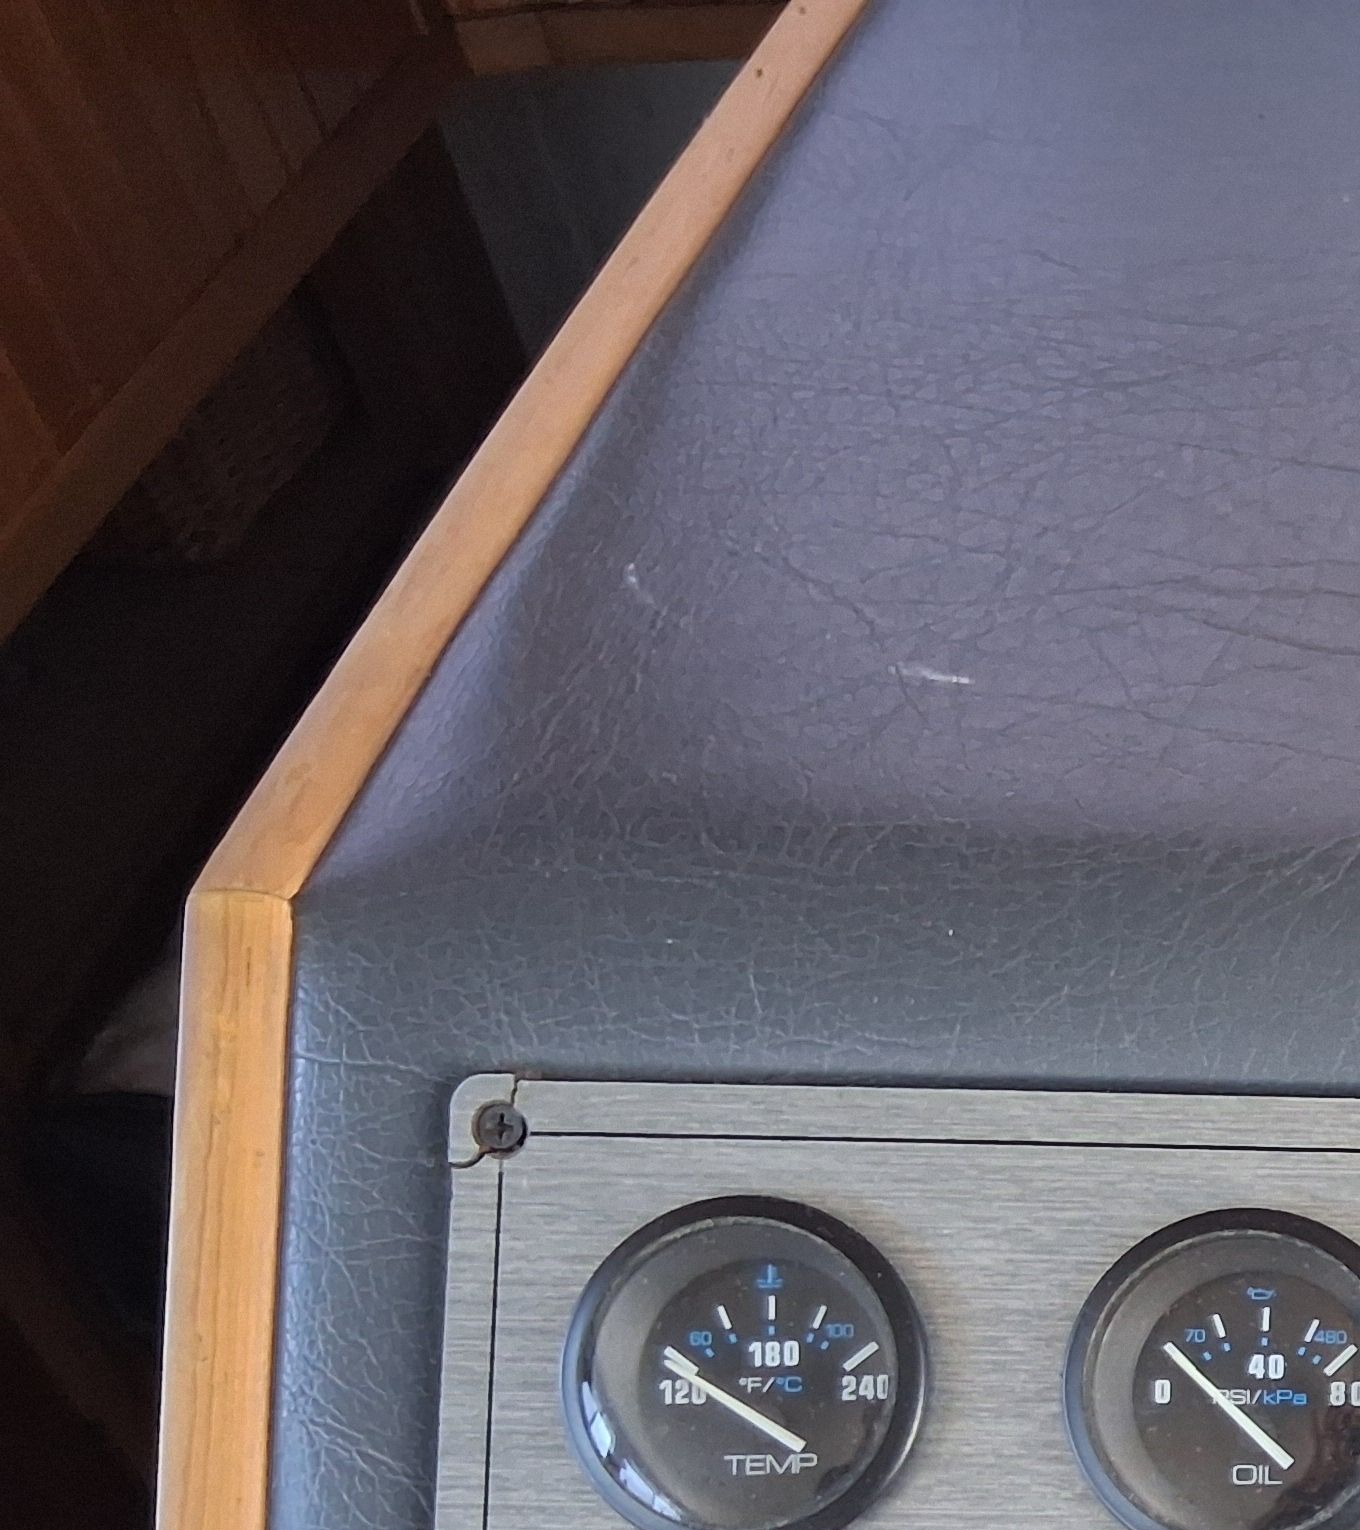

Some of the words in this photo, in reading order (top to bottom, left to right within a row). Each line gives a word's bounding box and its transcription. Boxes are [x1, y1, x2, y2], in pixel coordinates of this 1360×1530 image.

[748, 1340, 799, 1367] 180
[1248, 1354, 1286, 1380] 40
[658, 1379, 708, 1406] 120
[841, 1375, 889, 1401] 240
[1154, 1379, 1172, 1405] 0
[724, 1453, 818, 1476] TEMP
[1232, 1465, 1283, 1486] OIL
